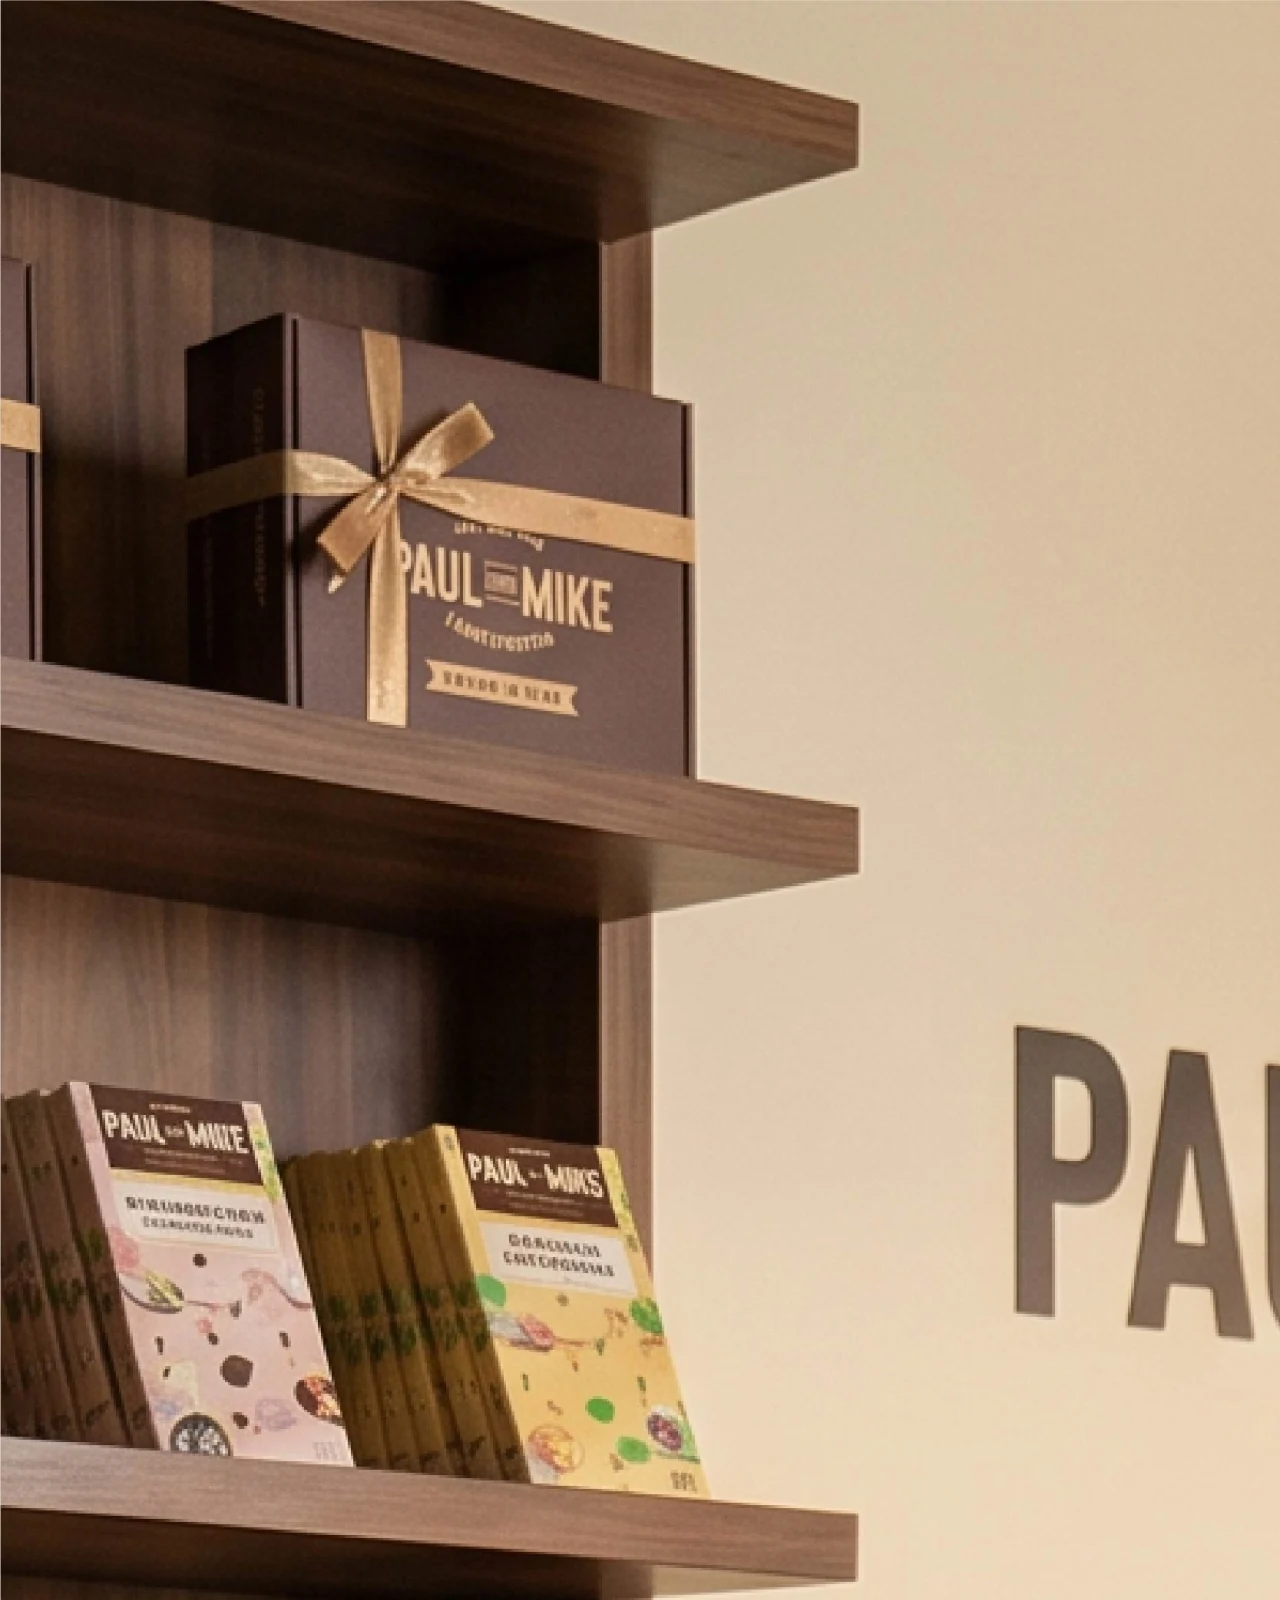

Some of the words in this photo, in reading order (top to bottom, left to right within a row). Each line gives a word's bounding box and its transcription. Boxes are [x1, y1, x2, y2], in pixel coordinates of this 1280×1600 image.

[521, 565, 613, 634] MIKE
[102, 1109, 167, 1146] PAUL
[466, 1152, 530, 1188] PAUL
